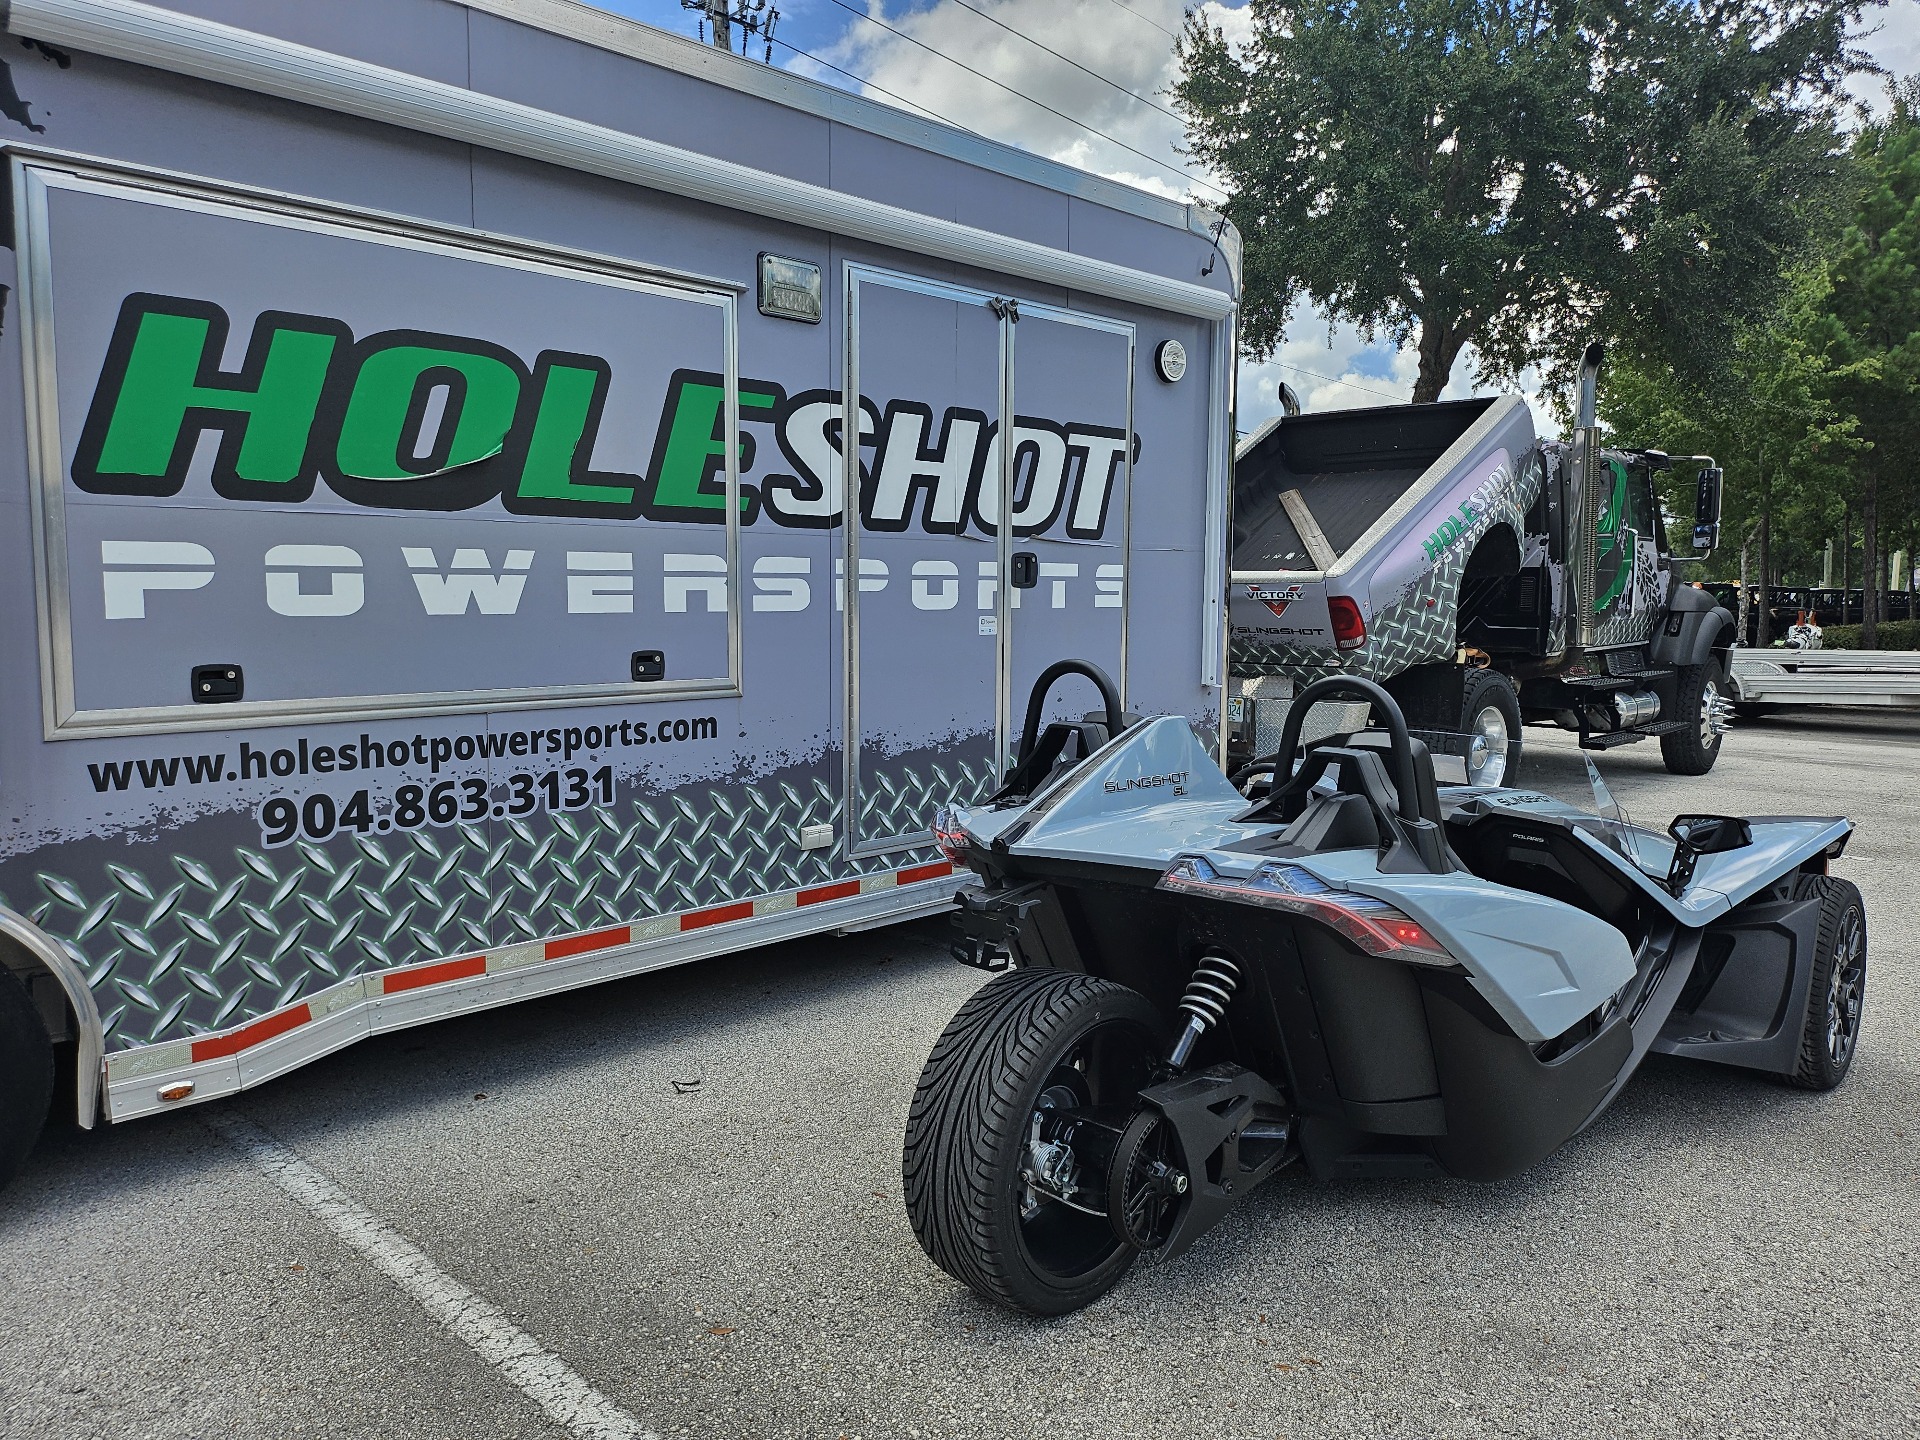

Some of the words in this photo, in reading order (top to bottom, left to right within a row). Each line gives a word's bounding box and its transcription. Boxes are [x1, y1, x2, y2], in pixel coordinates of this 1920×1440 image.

[71, 292, 1140, 540] HOLESHOT
[1421, 462, 1509, 562] HOLESHOT
[100, 540, 1123, 619] POWERSPORTS
[1244, 591, 1306, 600] VICTORY
[1237, 626, 1325, 636] SLINGSHOT
[87, 712, 719, 793] www.holeshotpowersports.com
[1103, 770, 1190, 794] SLINGSHOT
[1173, 785, 1188, 796] SL
[261, 764, 617, 846] 904.863.3131
